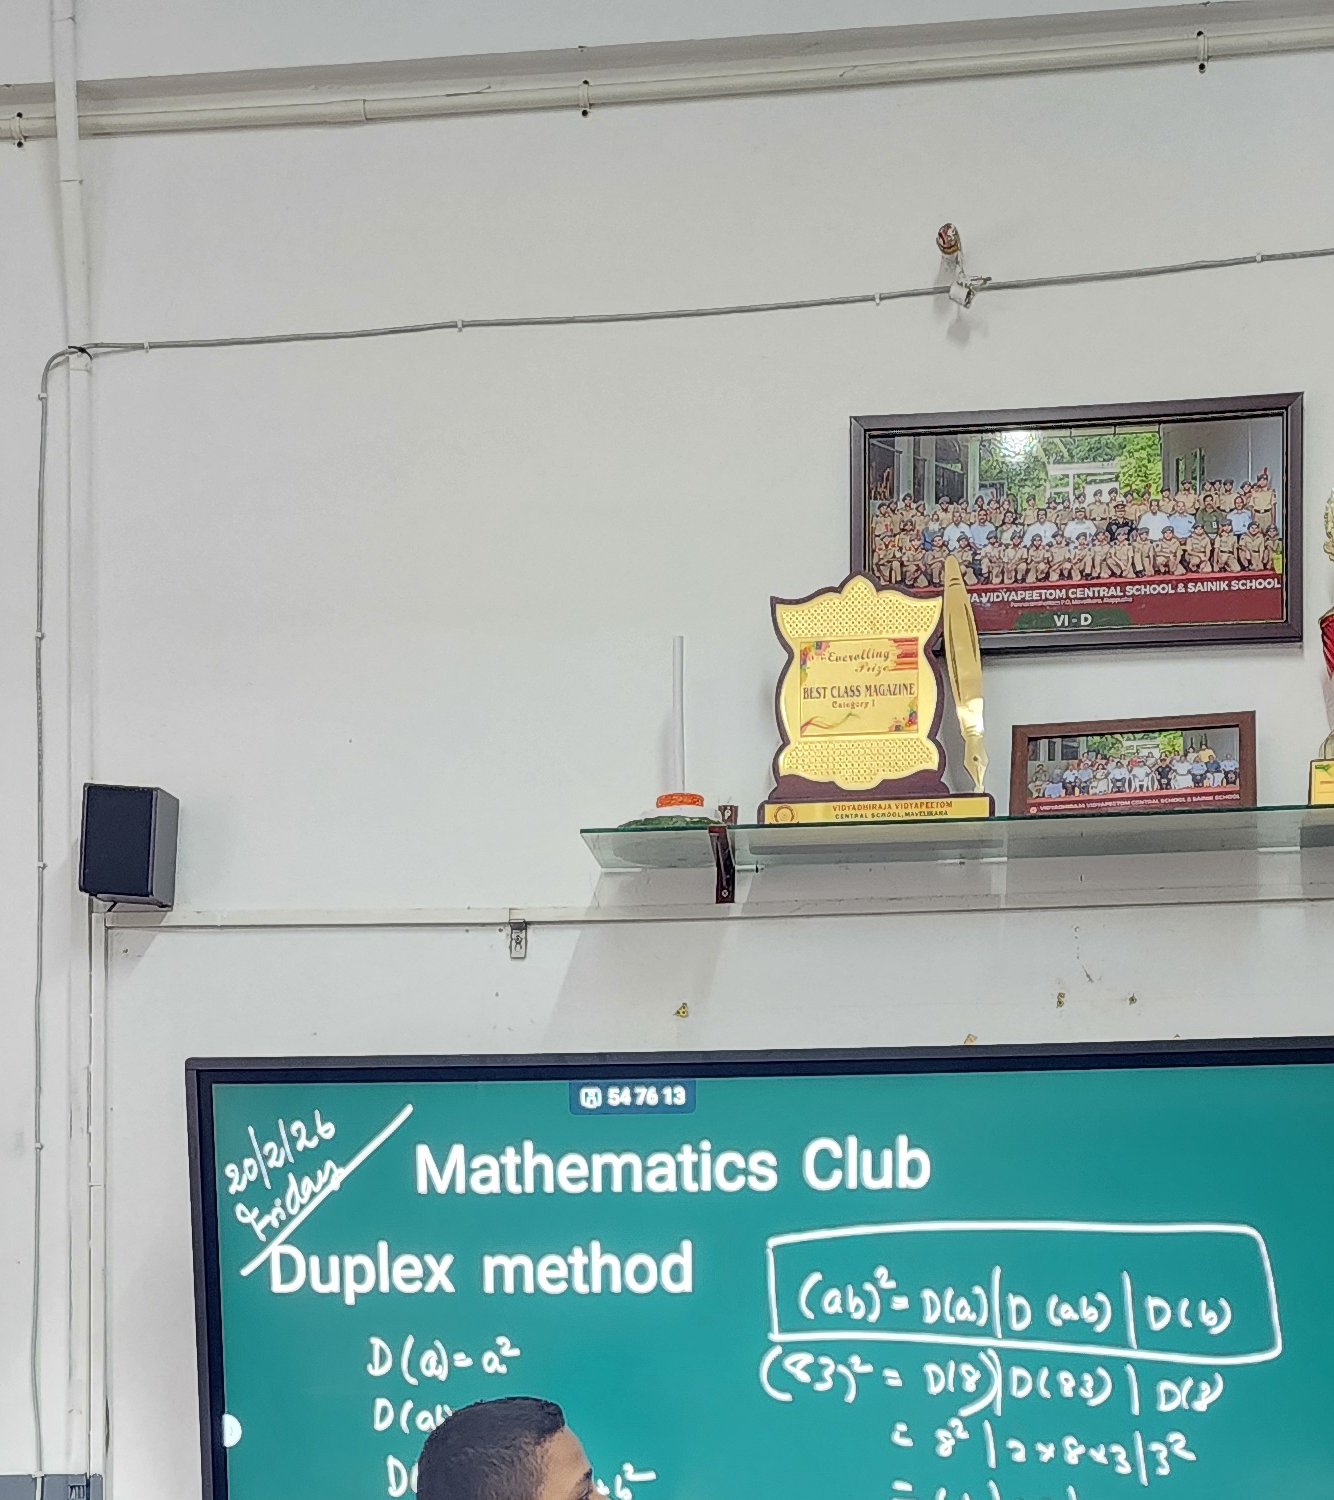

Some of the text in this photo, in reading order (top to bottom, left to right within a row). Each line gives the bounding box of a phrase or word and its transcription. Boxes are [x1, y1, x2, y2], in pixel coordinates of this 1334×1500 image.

[982, 589, 1066, 603] VIDYAPEETOM
[1068, 586, 1124, 599] CENTRAL
[1125, 583, 1175, 596] SCHOOL
[1177, 583, 1186, 593] &
[1187, 580, 1229, 593] SAINIK
[1231, 578, 1282, 590] SCHOOL
[1053, 614, 1069, 626] VI
[1080, 613, 1092, 625] D
[854, 662, 892, 677] Prize
[803, 682, 916, 699] BEST CLASS MAGAZINE
[832, 701, 870, 709] Category
[607, 1085, 686, 1107] 54 76 13
[224, 1109, 336, 1195] 20/2/26
[415, 1137, 931, 1194] Mathematics Club
[269, 1239, 694, 1306] Duplex method
